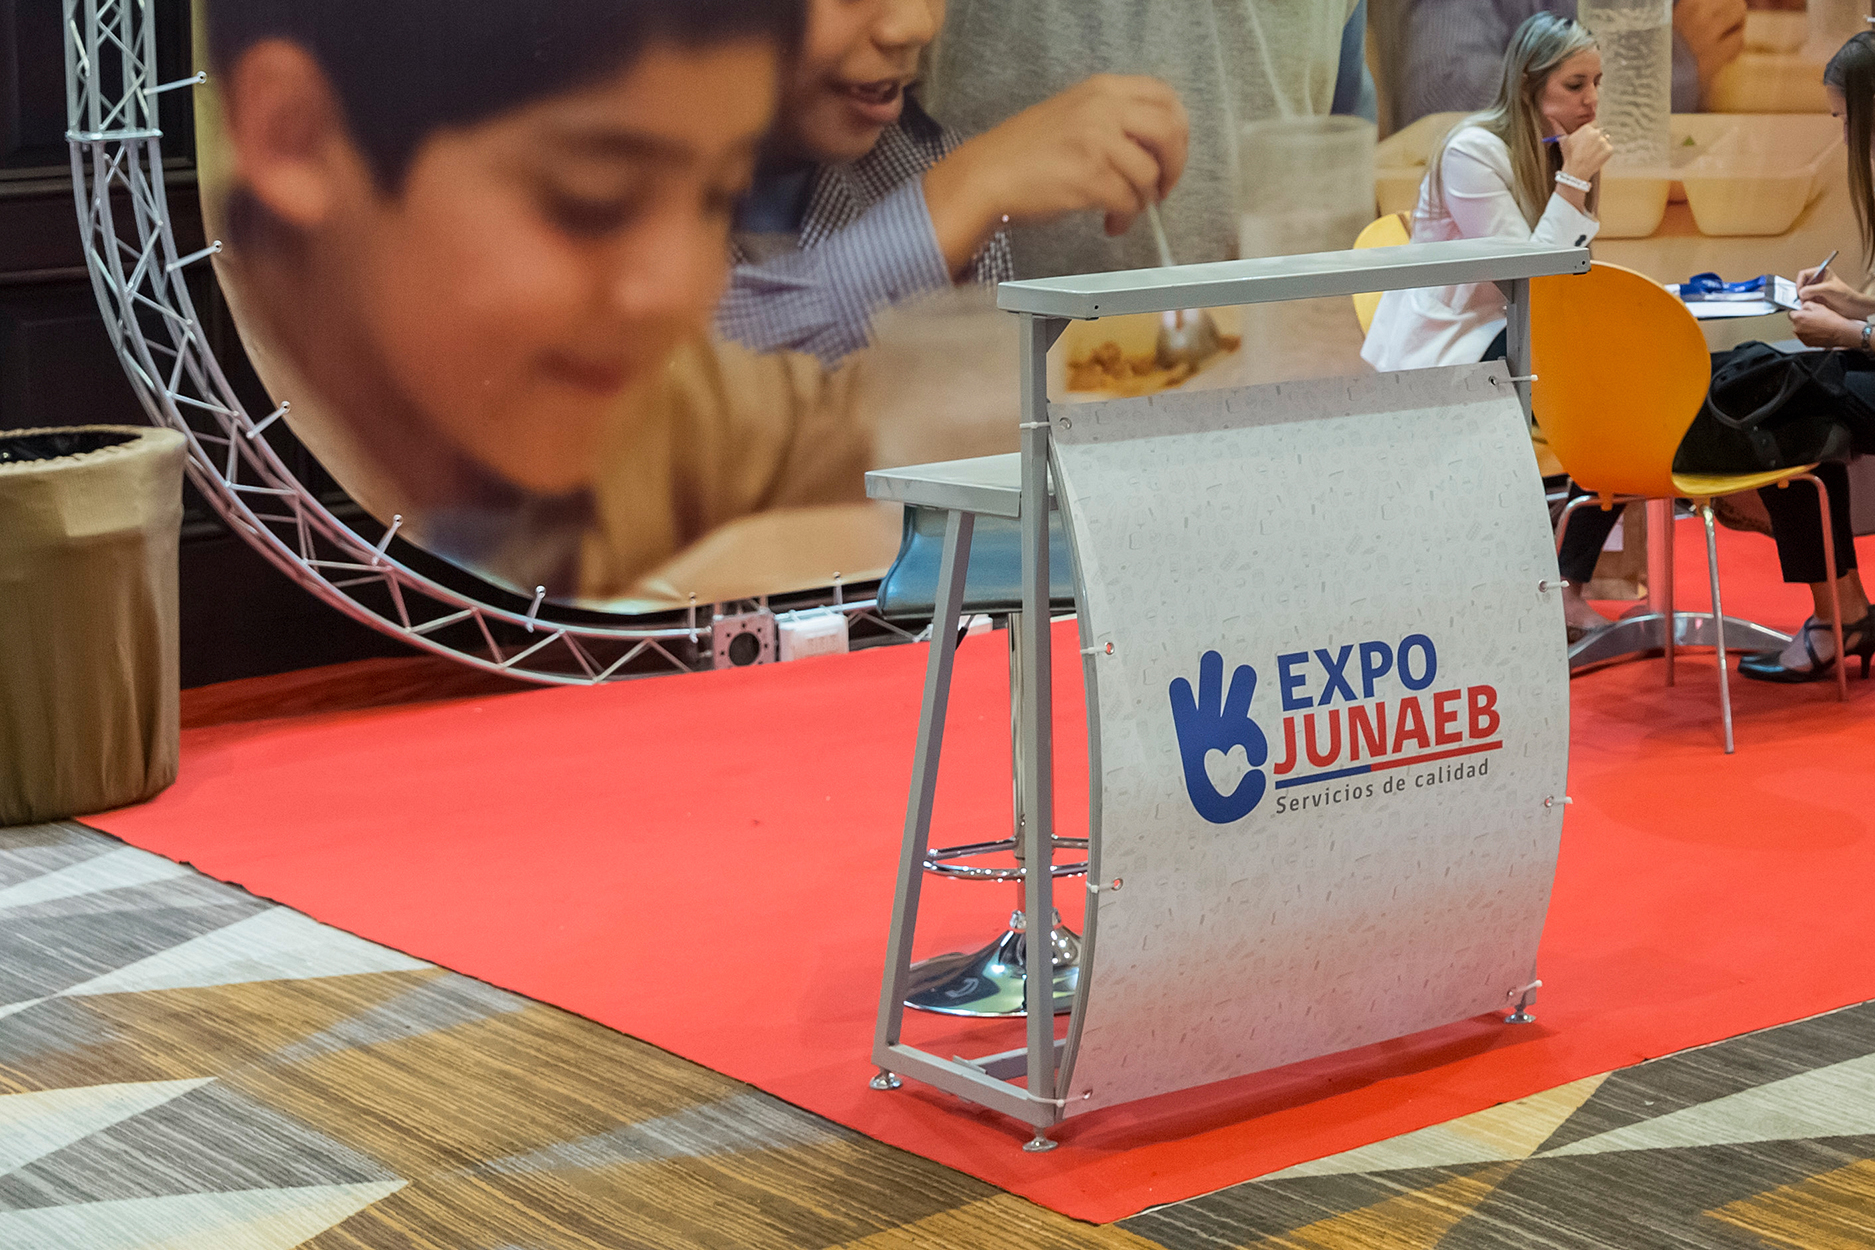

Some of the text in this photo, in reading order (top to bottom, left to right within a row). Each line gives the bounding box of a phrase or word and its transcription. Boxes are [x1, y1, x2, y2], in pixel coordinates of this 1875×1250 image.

[1276, 633, 1438, 712] EXPO
[1273, 684, 1501, 775] JUNAEB
[1275, 758, 1489, 815] Servicios de calidad
